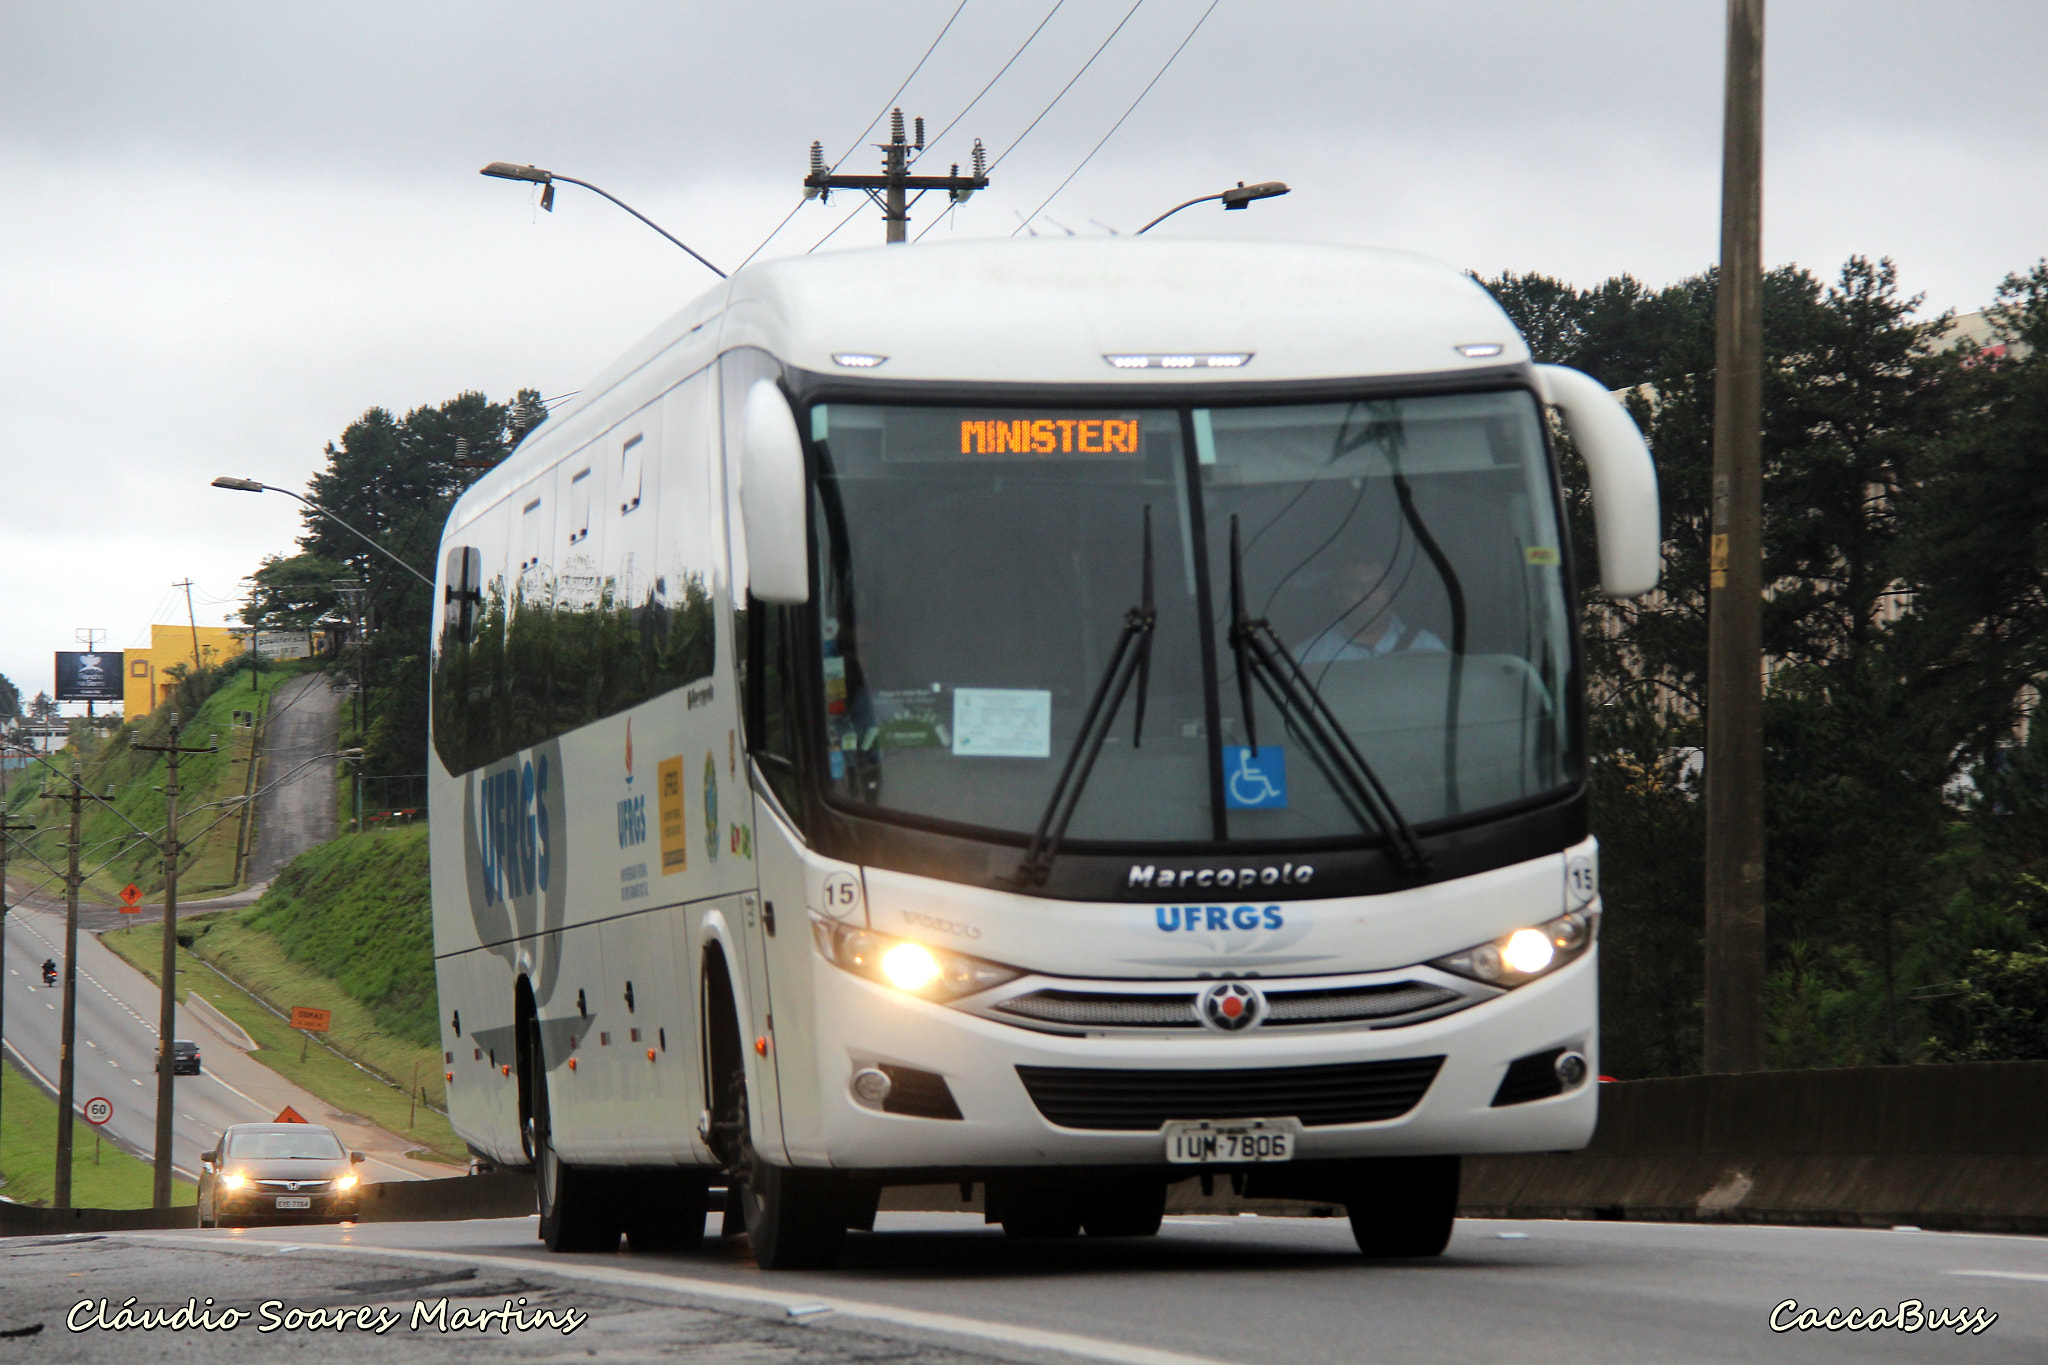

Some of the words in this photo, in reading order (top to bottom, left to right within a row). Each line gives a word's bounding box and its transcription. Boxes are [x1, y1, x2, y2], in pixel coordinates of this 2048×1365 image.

[961, 419, 1138, 454] MINISTERI
[481, 753, 550, 907] UFRGS
[616, 794, 646, 850] UFRGS
[1127, 862, 1315, 890] Marcopolo
[1573, 868, 1593, 890] 15
[826, 883, 854, 906] 15
[1155, 905, 1284, 932] UFRGS
[298, 1010, 324, 1020] OBRAS
[91, 1104, 107, 1115] 60
